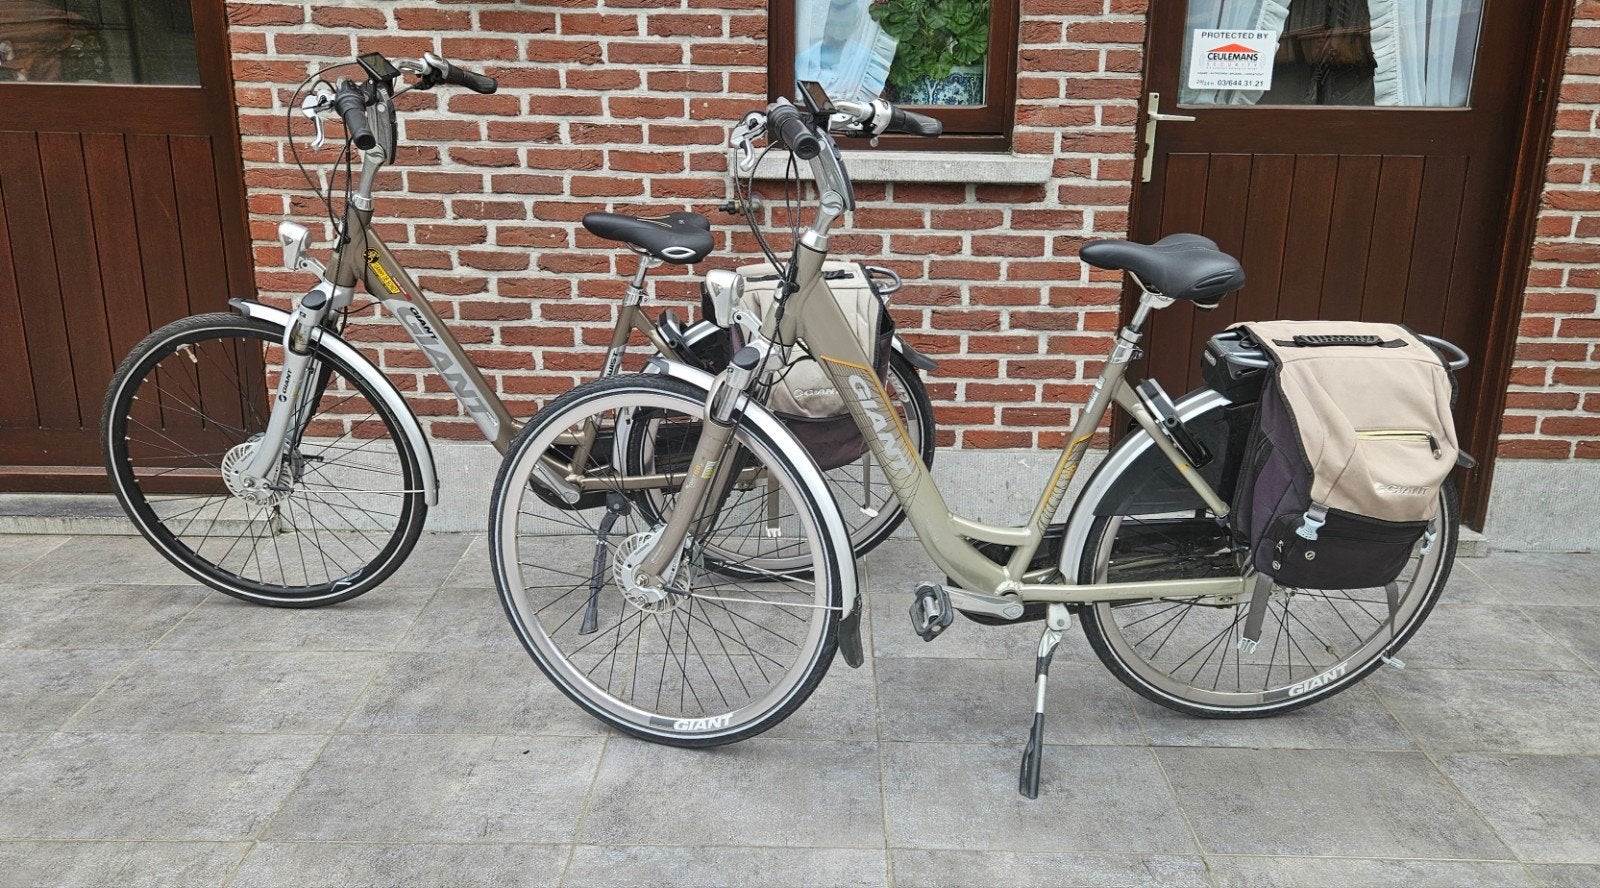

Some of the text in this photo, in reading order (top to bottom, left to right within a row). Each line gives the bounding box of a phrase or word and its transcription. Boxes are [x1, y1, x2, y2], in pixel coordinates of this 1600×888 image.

[1201, 31, 1269, 40] PROTECTED BY
[1207, 52, 1259, 61] CEULEMANS
[1217, 79, 1264, 87] 03/644.31.21
[410, 306, 438, 340] GIANT
[397, 306, 489, 413] GIANT
[607, 350, 618, 377] WIST
[282, 368, 292, 394] GIANT
[848, 374, 913, 475] GIANT
[1386, 484, 1431, 496] GIANT
[1288, 661, 1348, 697] GIANT
[672, 713, 734, 731] GIANT
